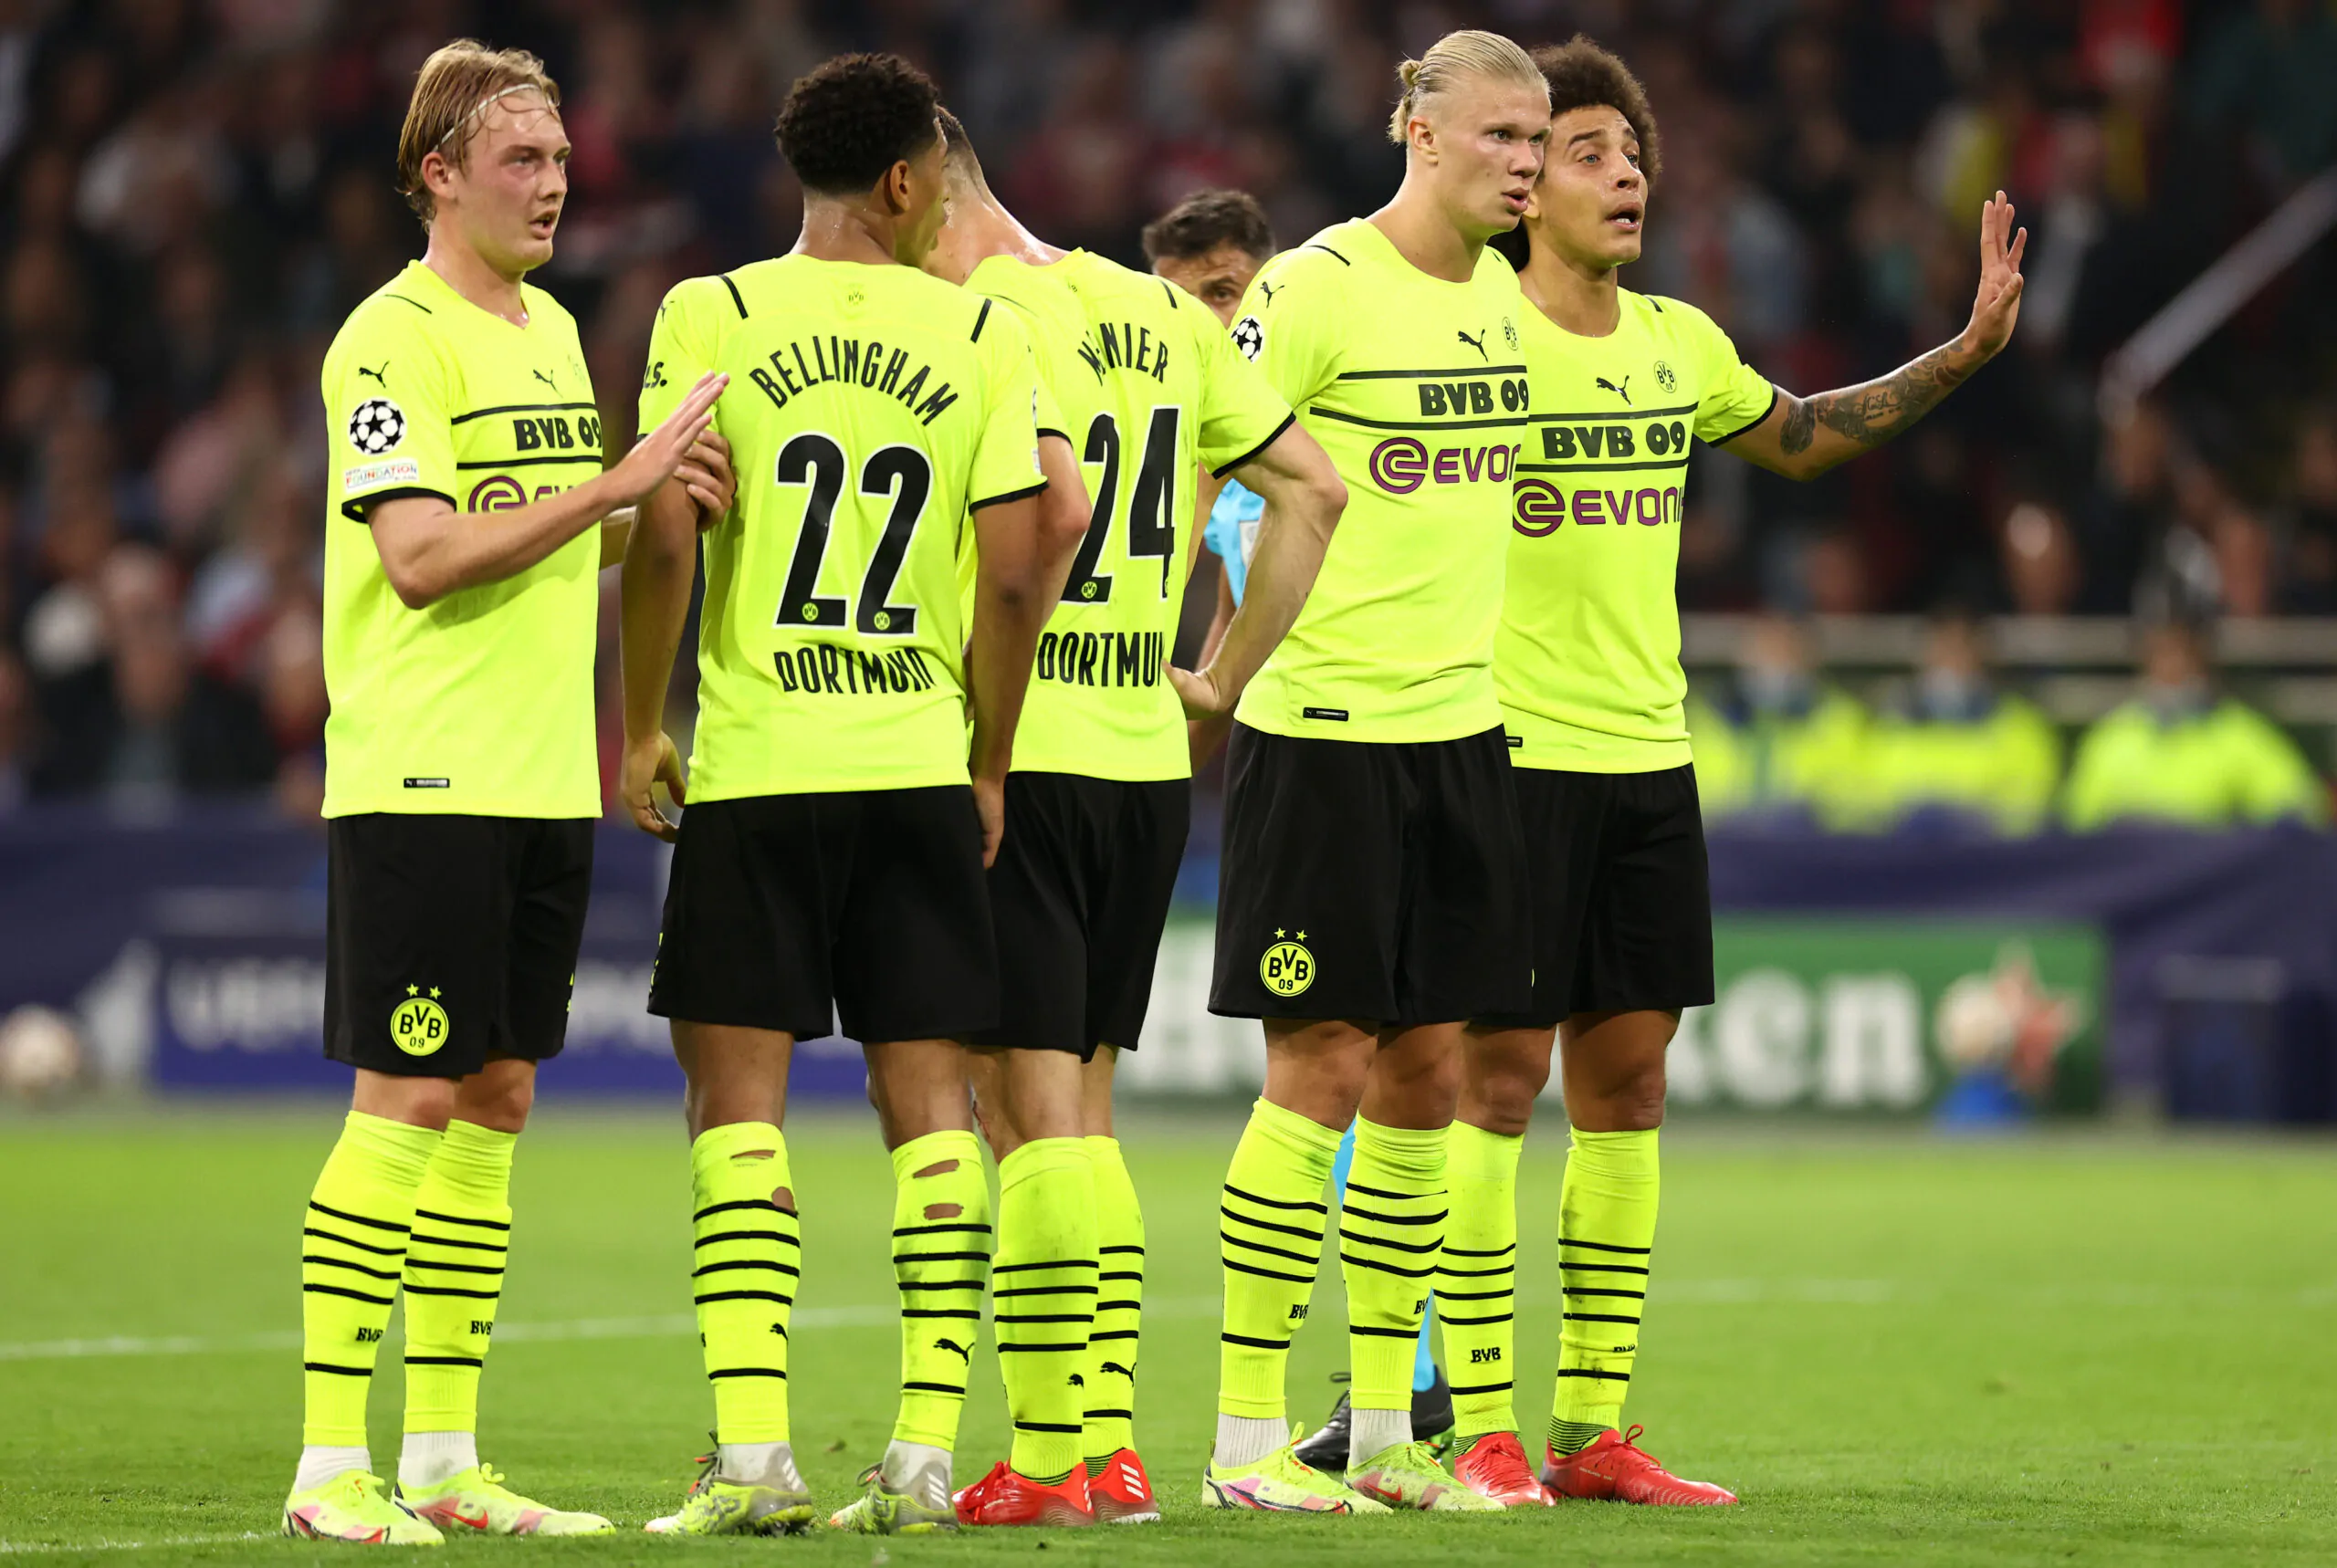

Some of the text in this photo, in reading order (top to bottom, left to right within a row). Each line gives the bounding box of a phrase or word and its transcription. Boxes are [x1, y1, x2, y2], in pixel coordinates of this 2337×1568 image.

[1077, 322, 1168, 387] MNIER
[749, 335, 959, 427] BELLINGHAM
[1657, 363, 1675, 384] BVB
[1418, 378, 1529, 416] BVB 09
[513, 417, 574, 451] BVB
[1541, 421, 1685, 460] BVB 09
[1433, 444, 1522, 484] EVON
[1058, 405, 1179, 604] 24
[776, 434, 932, 634] 22
[1037, 632, 1163, 687] DORTMU
[1268, 947, 1309, 981] BVB
[1278, 978, 1294, 990] 09
[399, 1005, 442, 1039] BVB
[410, 1036, 425, 1049] 09
[1414, 1297, 1429, 1314] BV
[470, 1320, 493, 1335] BVB
[1471, 1347, 1502, 1363] BVB
